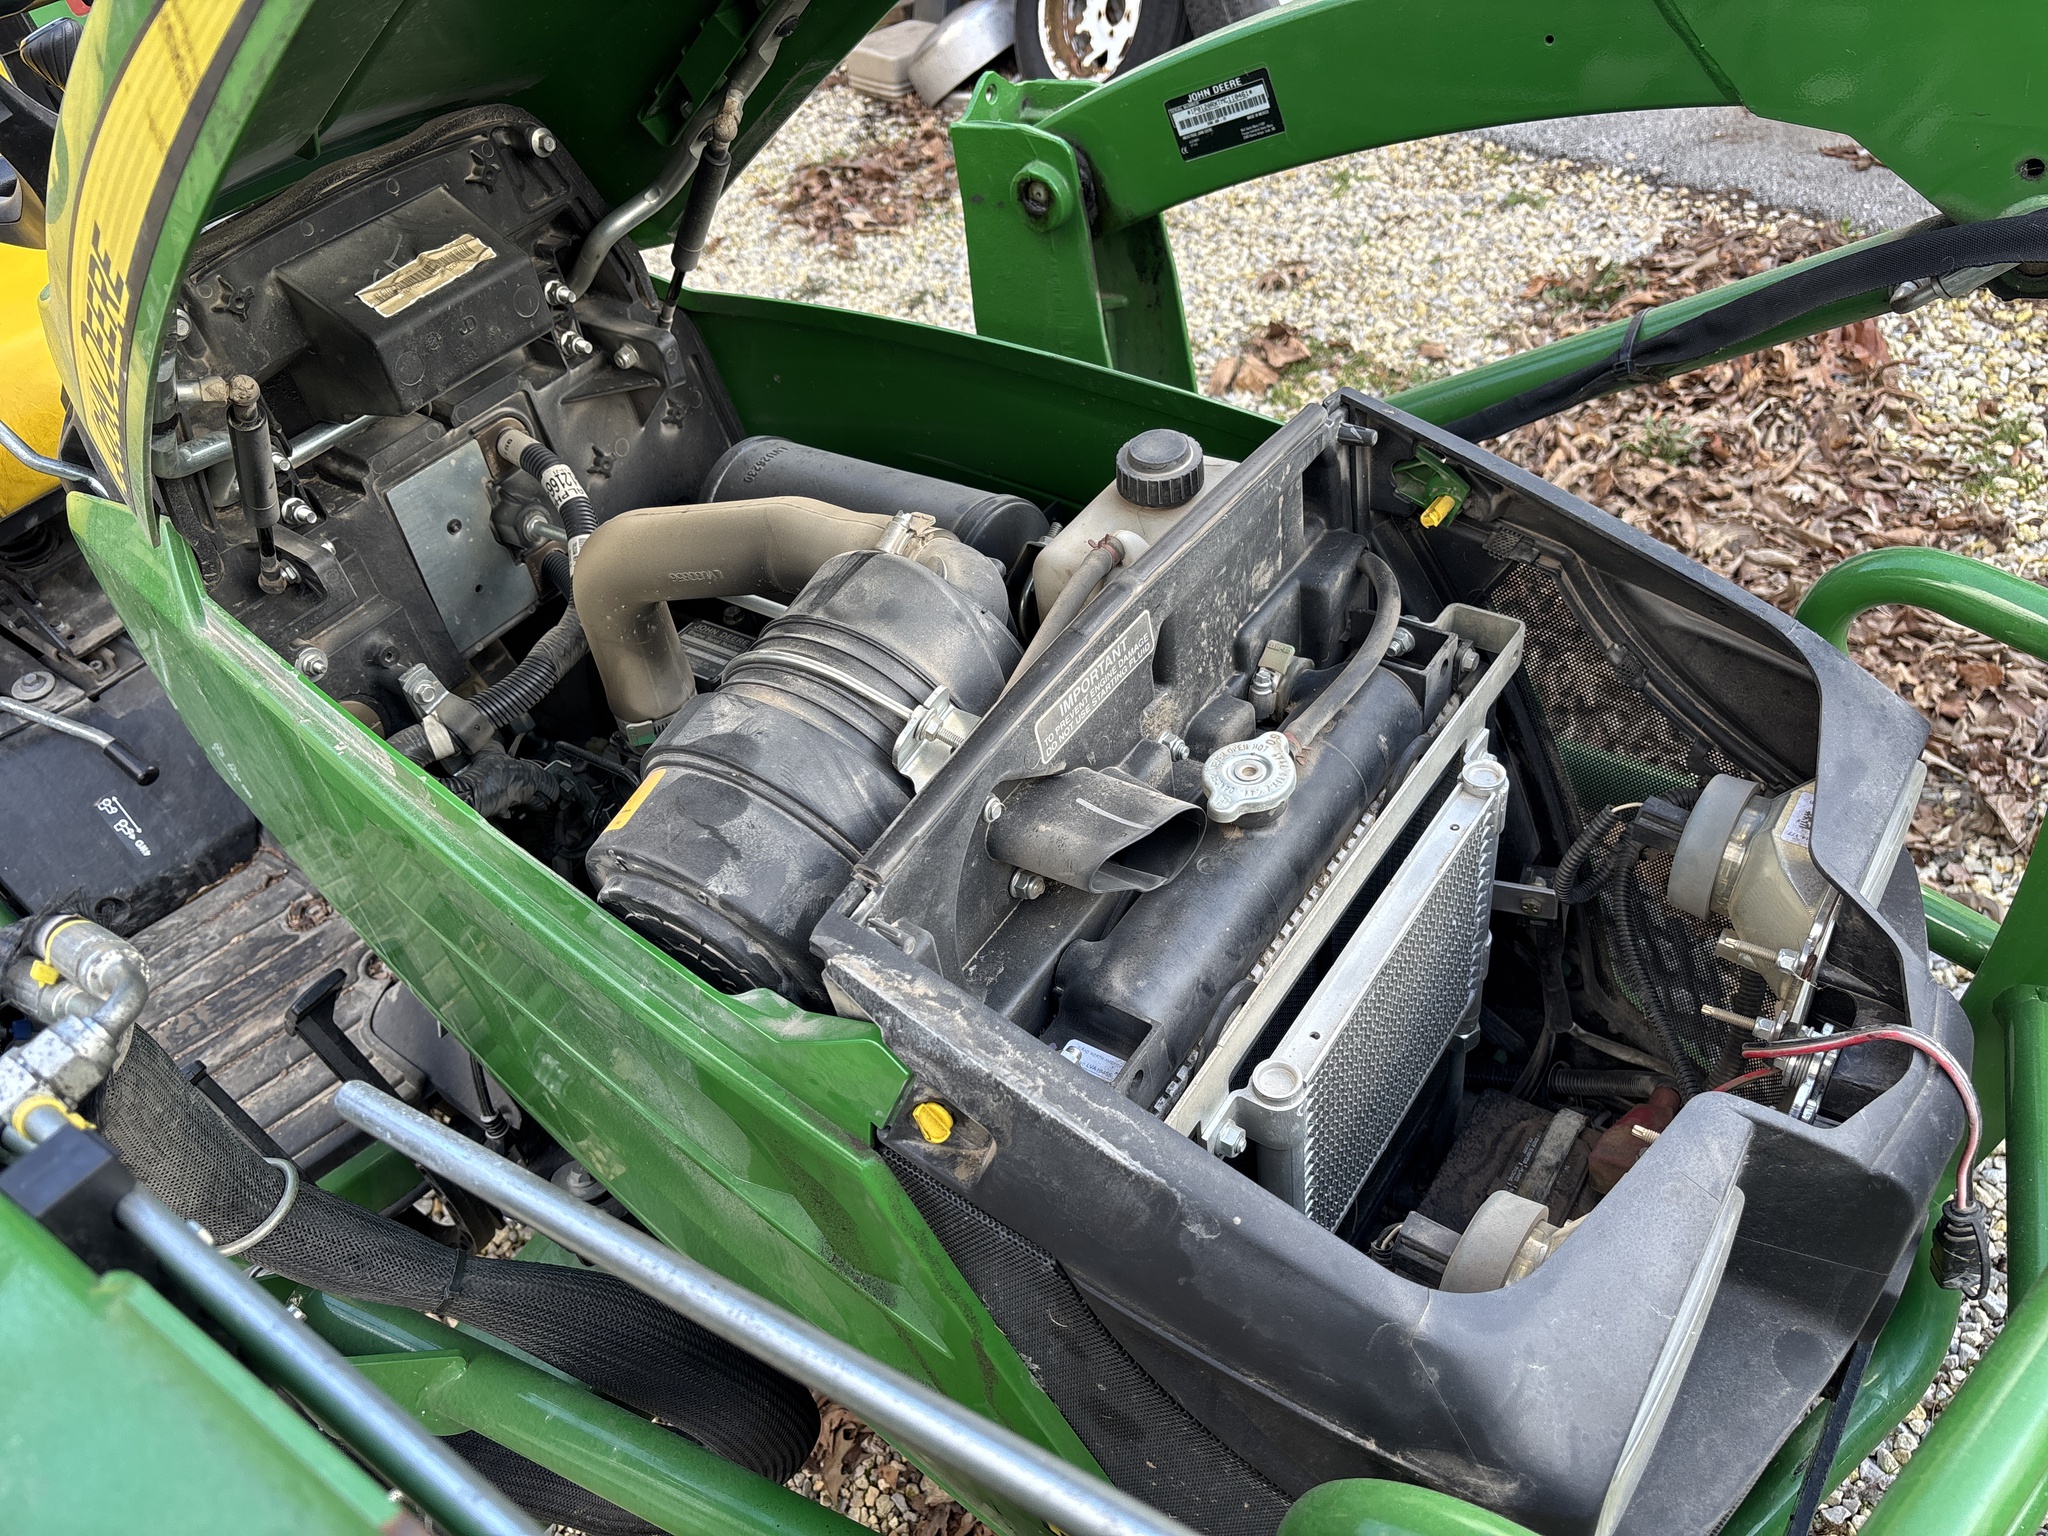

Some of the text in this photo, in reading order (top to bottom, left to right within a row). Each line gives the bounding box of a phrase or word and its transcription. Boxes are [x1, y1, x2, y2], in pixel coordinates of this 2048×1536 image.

[1187, 77, 1242, 103] JOHN DEERE
[79, 219, 127, 403] DEERE
[694, 624, 750, 646] JOHN DEERE
[1043, 633, 1149, 746] TO PREVENT ENGINE DAMAGE
[1045, 642, 1150, 757] DO NOT USE STARTING FLUID
[1059, 637, 1128, 716] IMPORTANT
[1227, 744, 1249, 754] OPEN
[1252, 744, 1269, 753] HOT
